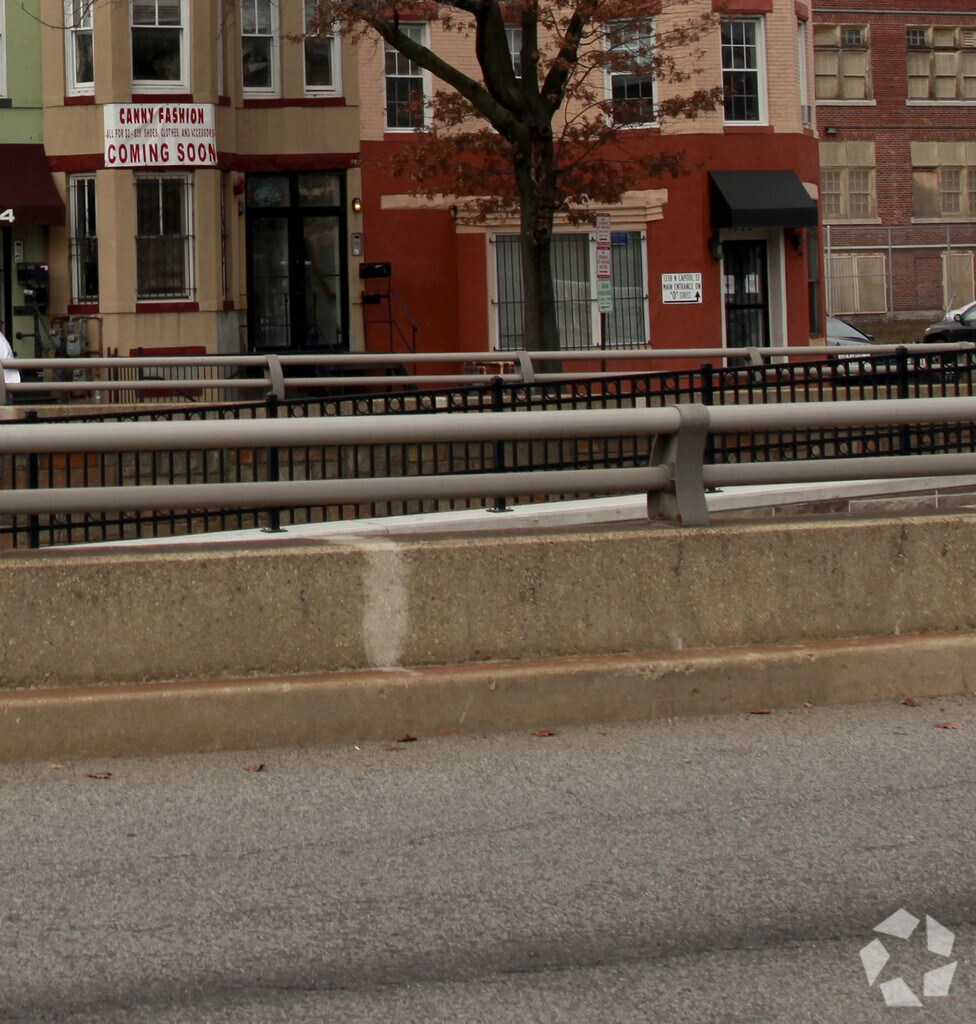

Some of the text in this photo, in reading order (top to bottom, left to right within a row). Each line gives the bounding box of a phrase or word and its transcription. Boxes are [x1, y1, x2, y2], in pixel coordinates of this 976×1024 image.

[119, 107, 205, 125] CANNY FASHION
[107, 142, 217, 164] COMING SOON
